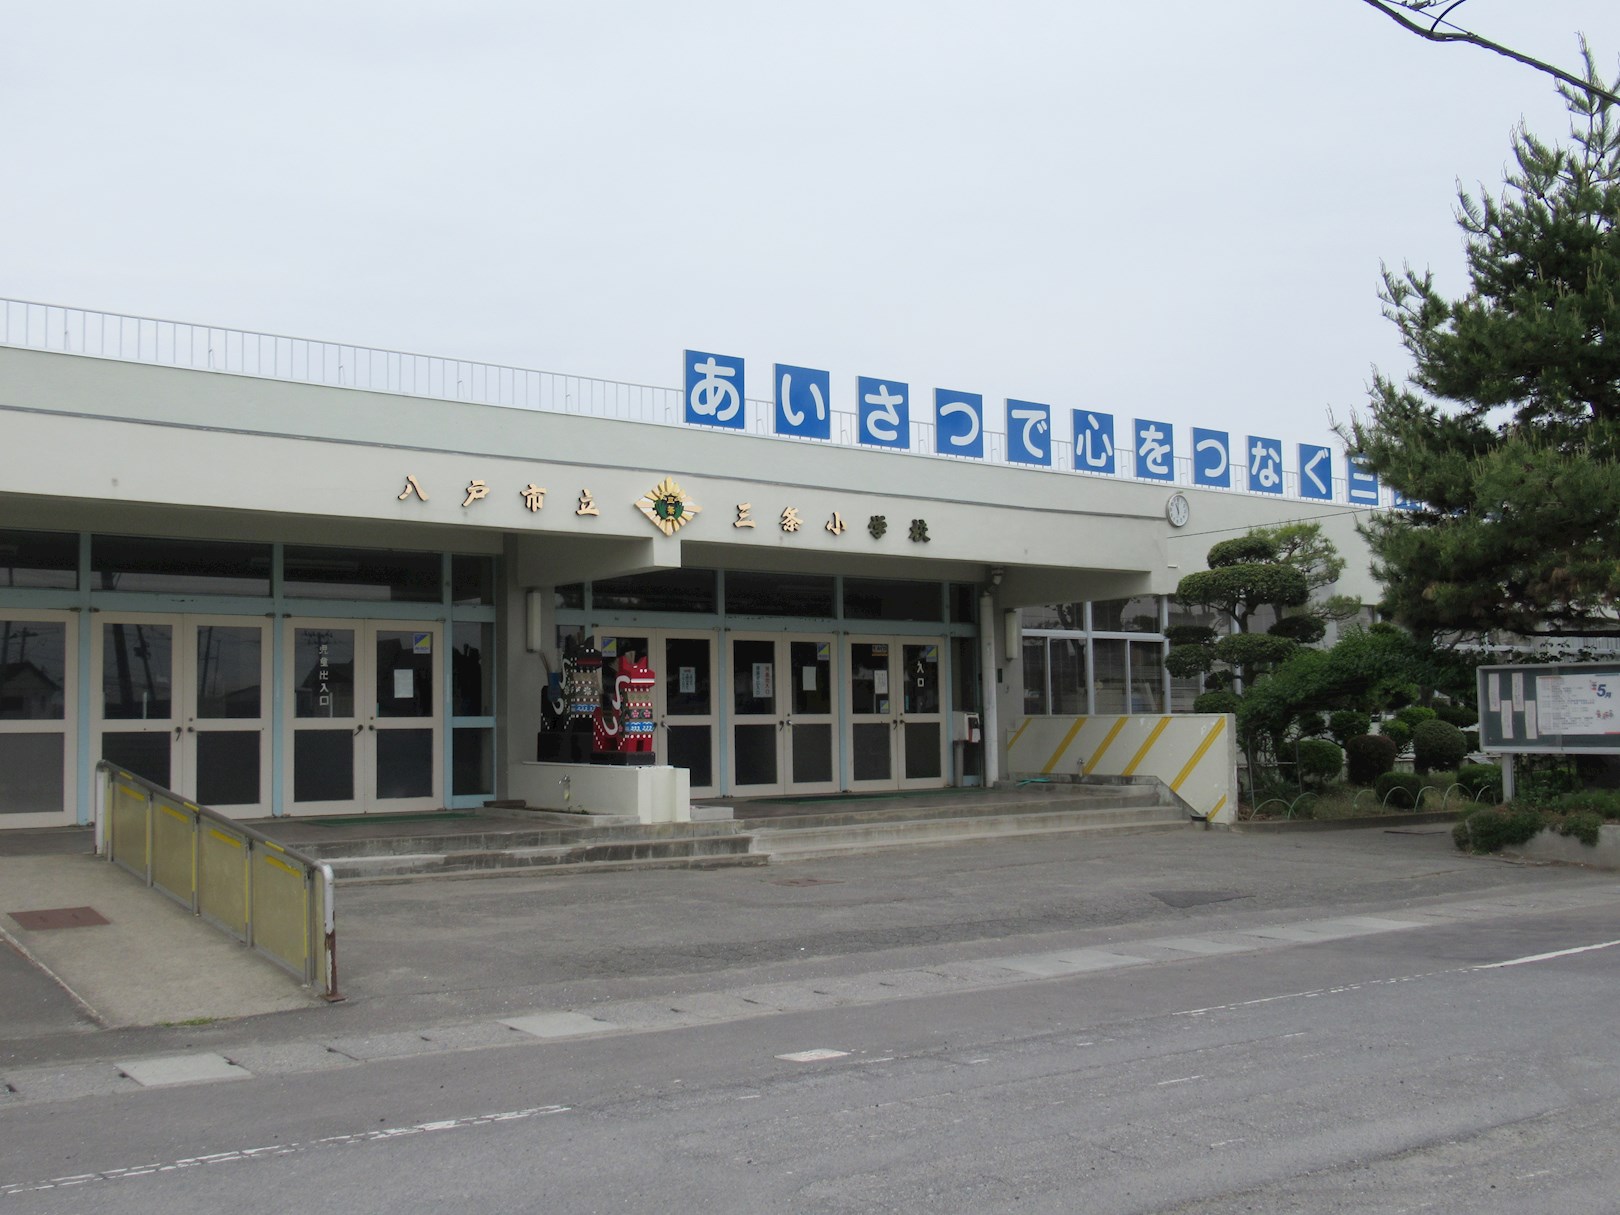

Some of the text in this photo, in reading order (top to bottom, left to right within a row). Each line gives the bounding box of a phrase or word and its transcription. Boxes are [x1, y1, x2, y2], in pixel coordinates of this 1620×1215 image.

[689, 357, 1421, 506] あいさつで心をつなぐ三
[398, 474, 599, 516] 八戸市立
[917, 660, 924, 687] 入口
